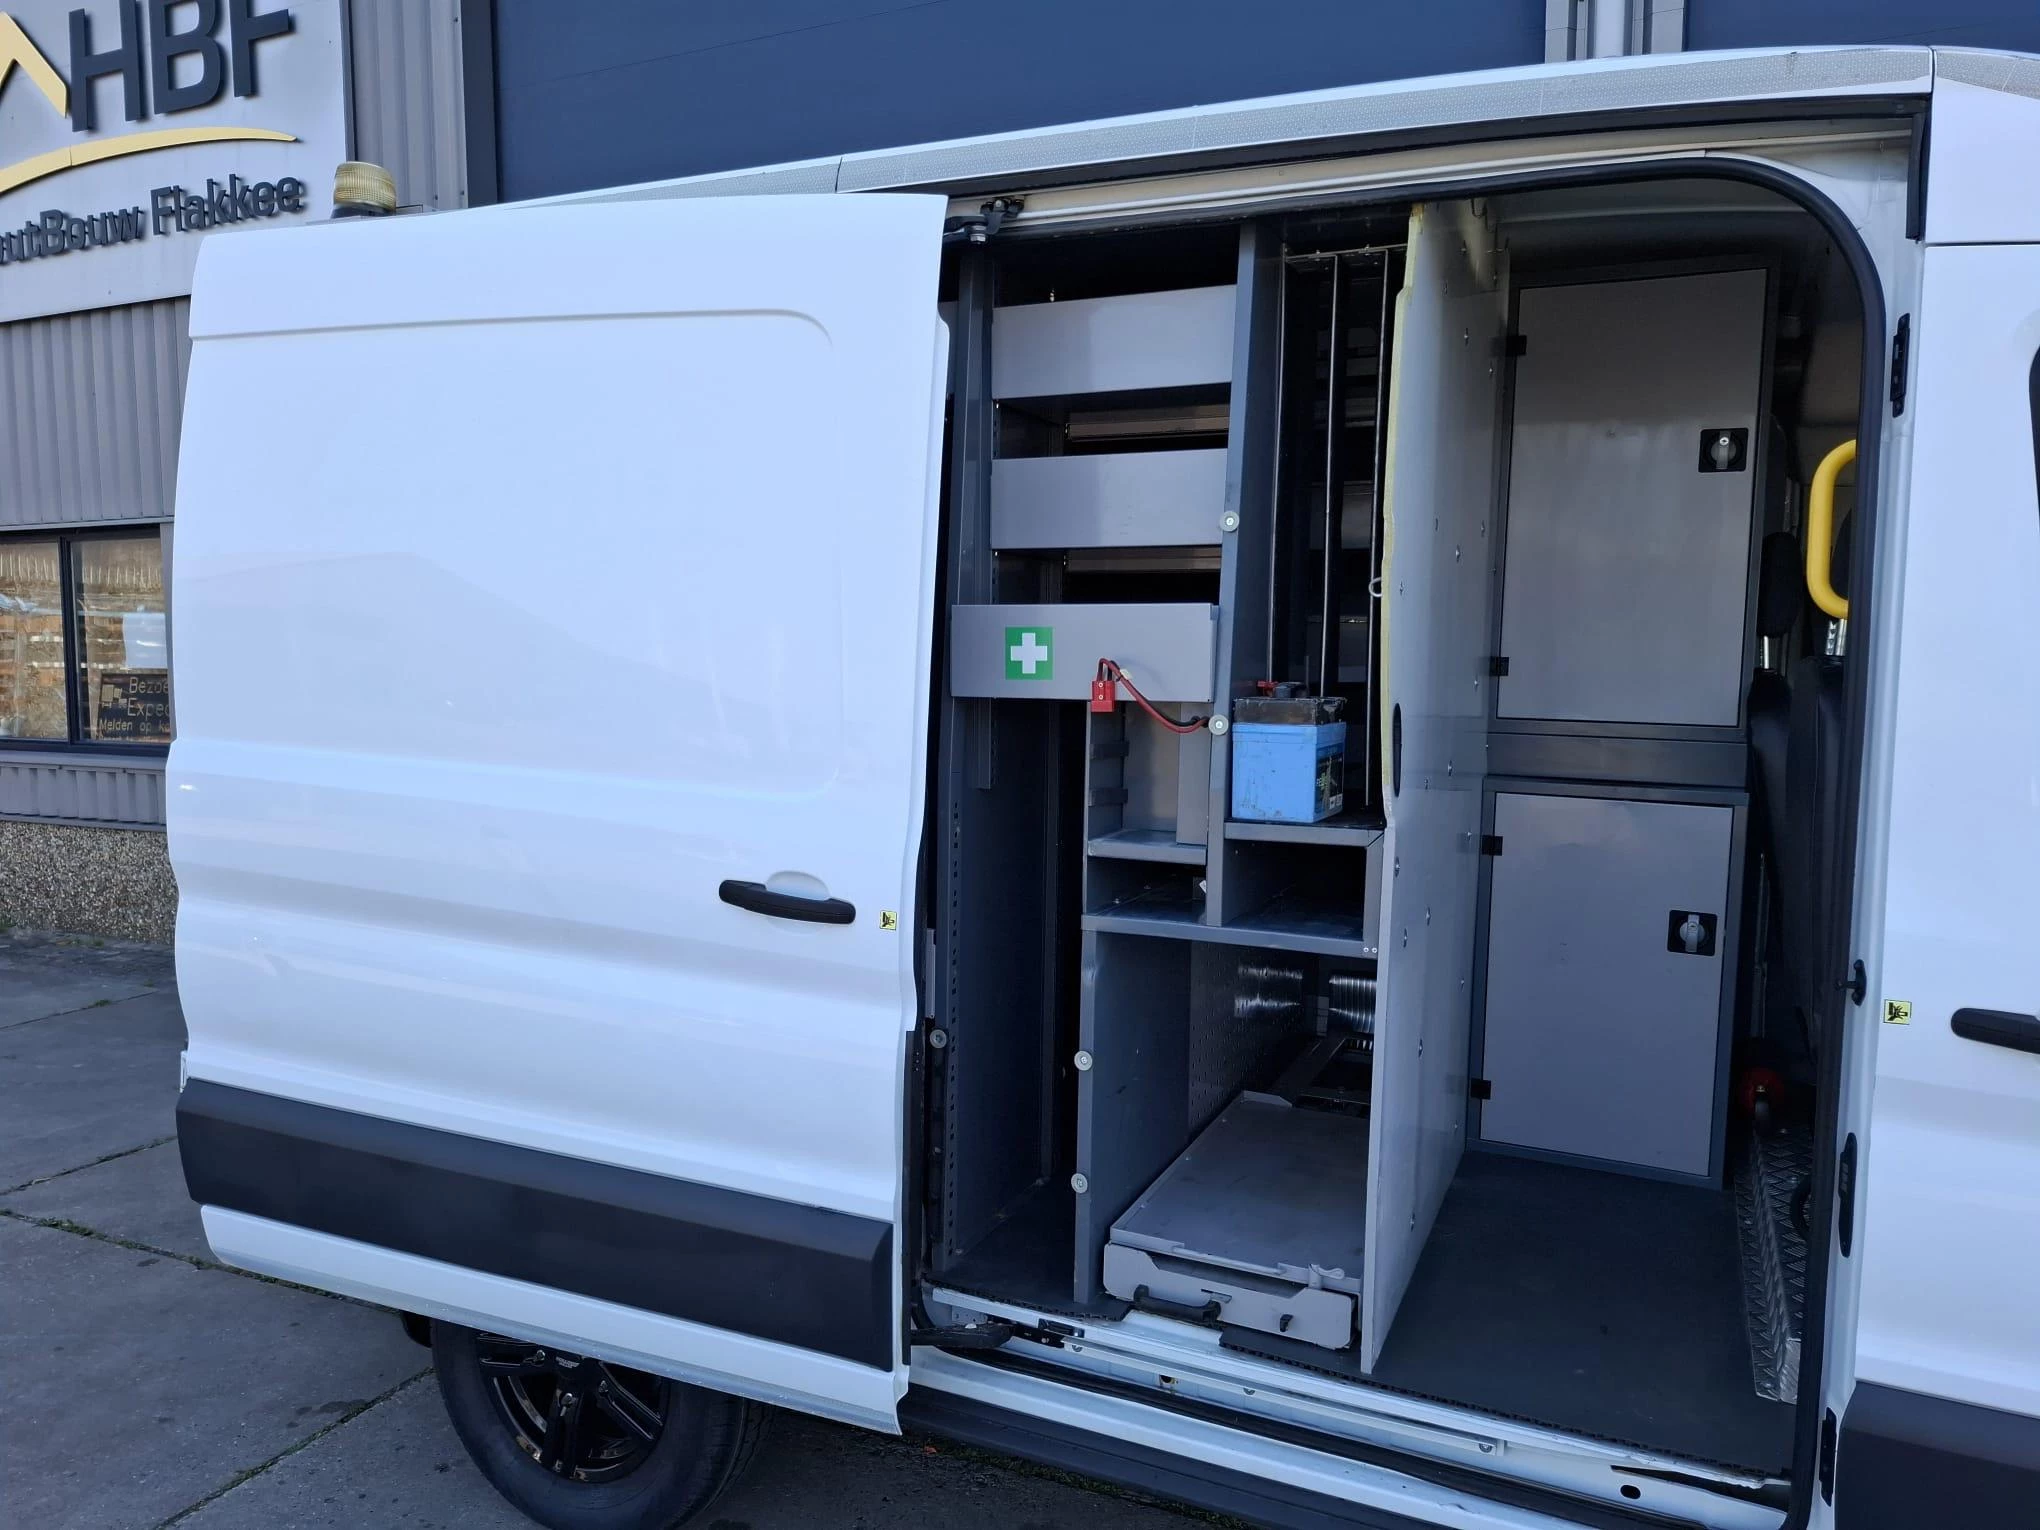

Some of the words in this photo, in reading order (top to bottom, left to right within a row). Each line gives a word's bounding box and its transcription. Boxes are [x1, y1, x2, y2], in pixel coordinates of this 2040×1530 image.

[69, 0, 291, 132] HBF
[150, 174, 303, 236] Flakkee
[100, 718, 133, 732] Melden
[140, 721, 152, 735] op
